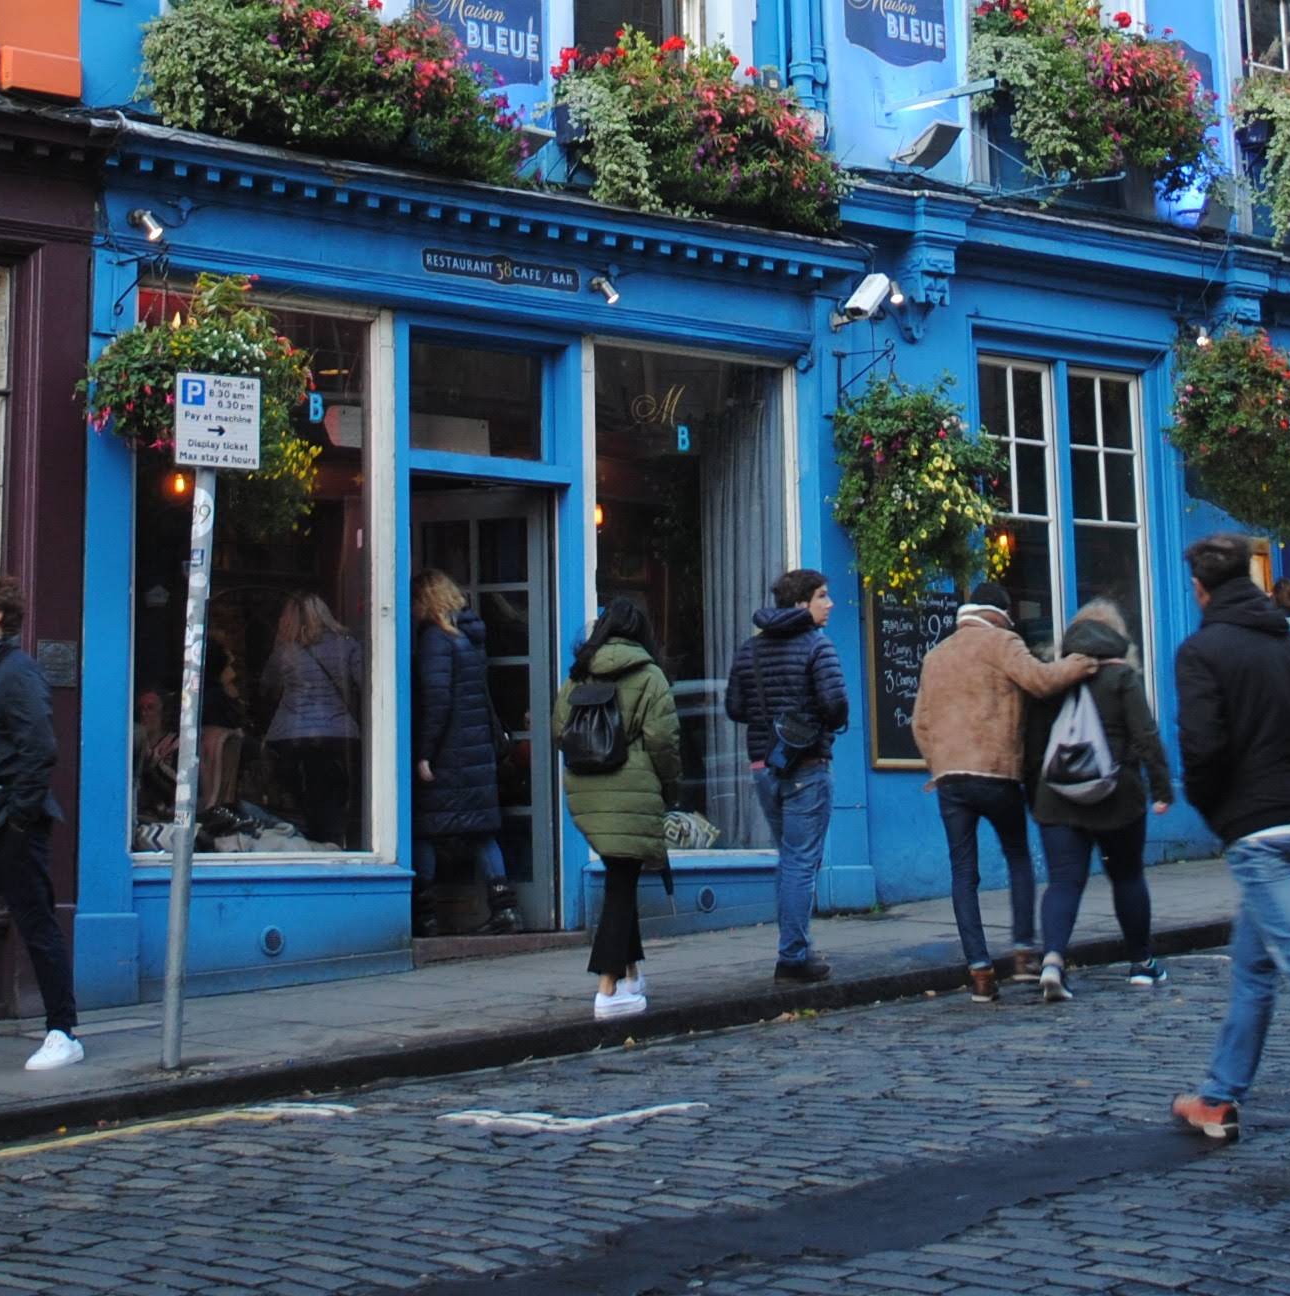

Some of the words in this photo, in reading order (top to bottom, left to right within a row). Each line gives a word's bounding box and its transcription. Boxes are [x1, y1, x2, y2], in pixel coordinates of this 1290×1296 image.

[886, 12, 946, 49] BLEUE
[466, 20, 540, 62] BLEUE
[426, 254, 494, 275] RESTAURANT
[552, 272, 574, 286] BAR
[213, 379, 233, 389] Mon
[240, 380, 255, 391] Sat
[184, 411, 200, 422] Pay
[203, 413, 213, 421] at
[215, 413, 252, 424] machine
[240, 403, 254, 412] pm
[309, 392, 324, 423] B
[188, 439, 220, 451] Display
[223, 441, 249, 451] ticket
[677, 425, 691, 451] B
[179, 451, 198, 461] Max
[201, 453, 219, 463] stay
[223, 454, 229, 463] 4
[231, 455, 257, 465] hours
